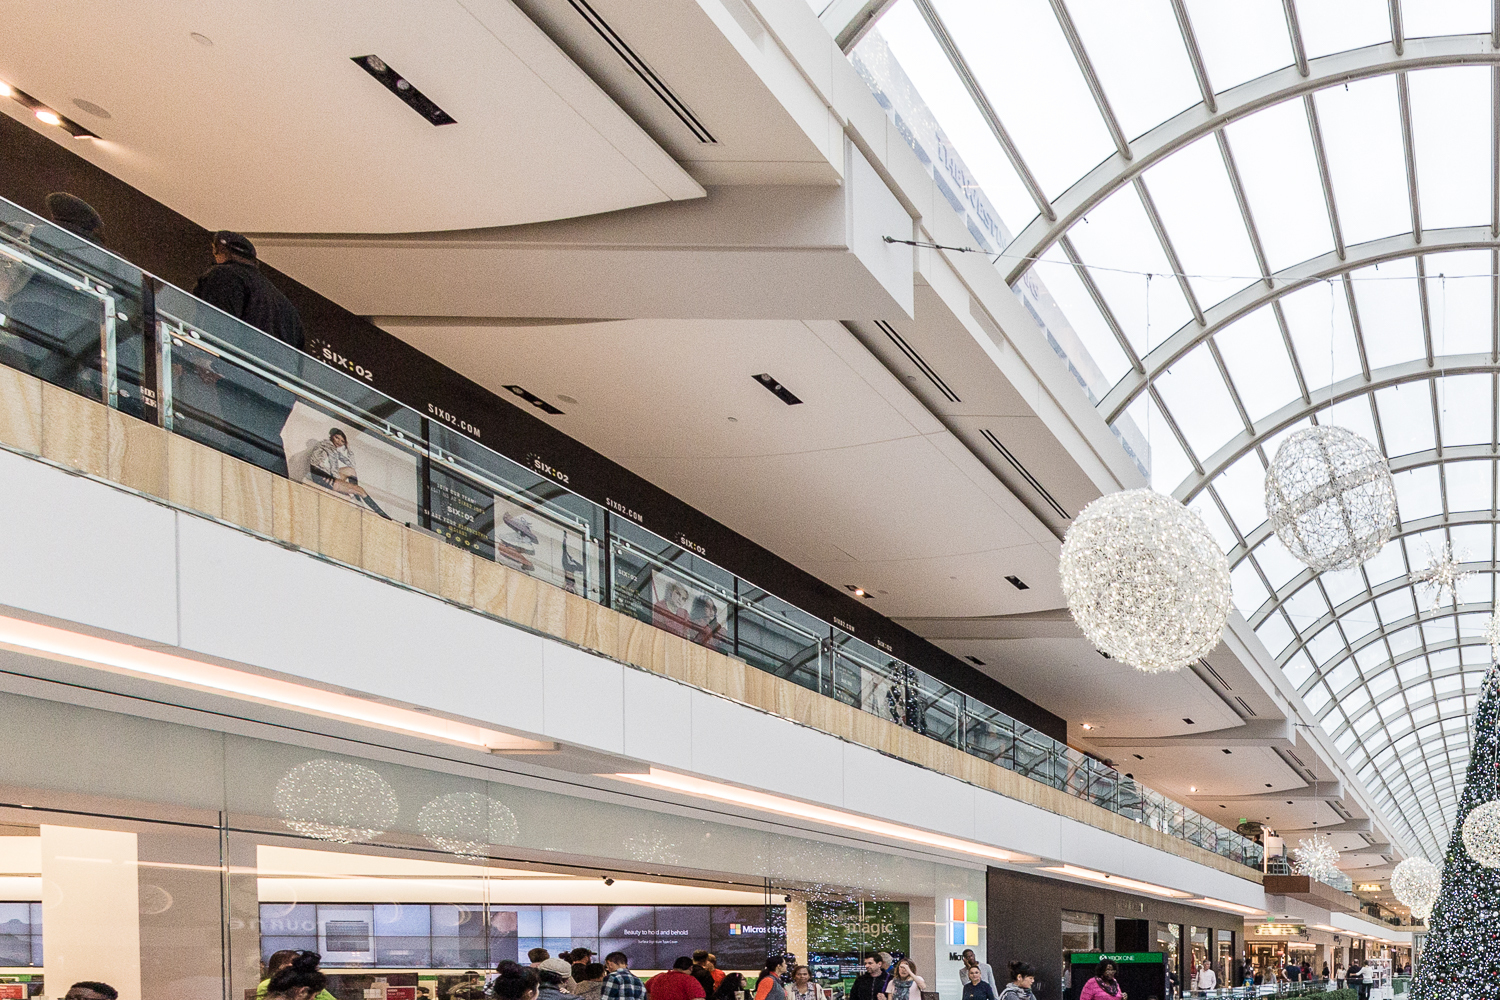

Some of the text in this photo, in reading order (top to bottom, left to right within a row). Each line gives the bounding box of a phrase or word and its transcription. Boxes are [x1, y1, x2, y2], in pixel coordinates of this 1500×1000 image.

[322, 348, 373, 382] SIX:02
[427, 403, 481, 438] SIX02.COM
[534, 459, 569, 484] SIX:02
[605, 497, 643, 523] SIX02.COM
[680, 537, 706, 556] SIX:02
[742, 925, 779, 934] Microsoft
[847, 920, 894, 938] magic
